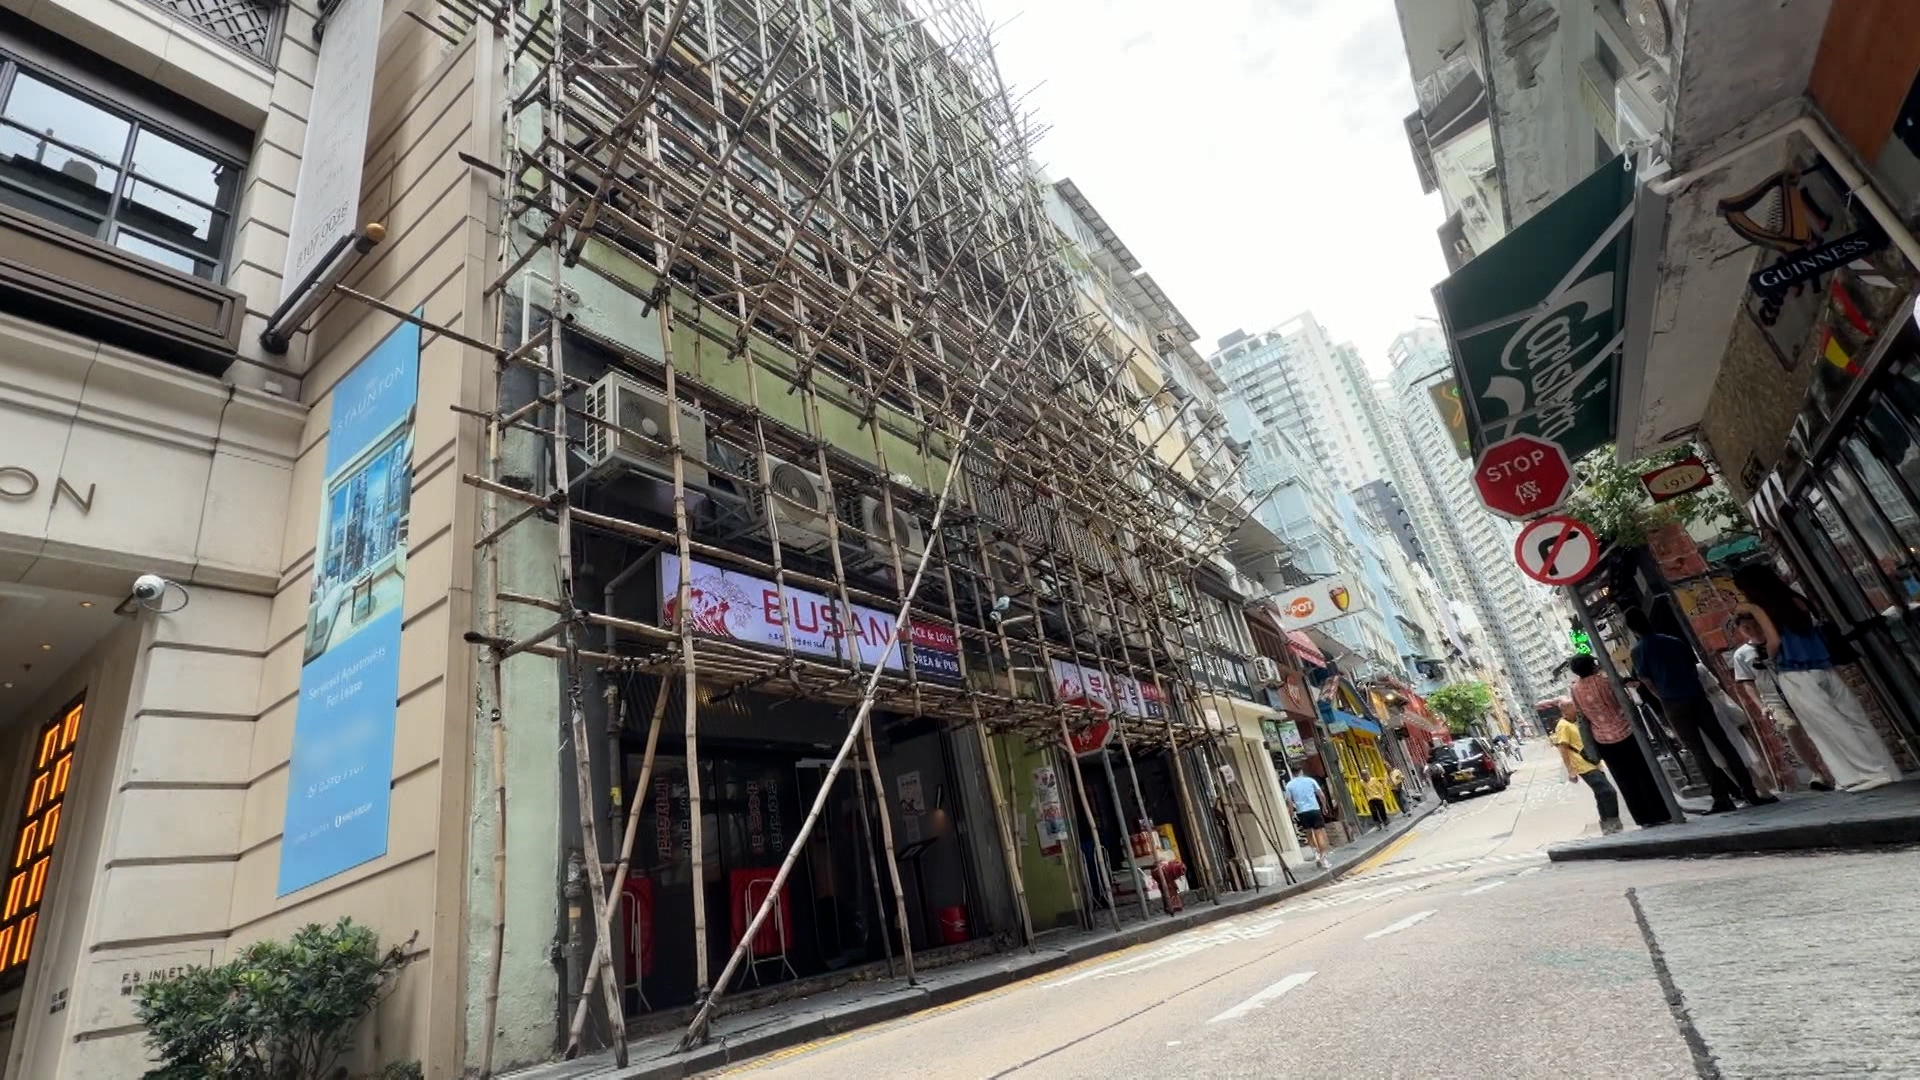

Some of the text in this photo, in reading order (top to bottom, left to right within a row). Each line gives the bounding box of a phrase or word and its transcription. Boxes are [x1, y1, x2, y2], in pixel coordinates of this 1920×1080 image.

[1759, 237, 1869, 286] GUINNESS
[334, 359, 405, 436] STAUNTON
[1486, 449, 1544, 482] STOP
[1663, 473, 1694, 490] 1911
[1515, 480, 1541, 505] 停
[762, 588, 891, 647] BUSAN
[913, 652, 934, 668] OREA
